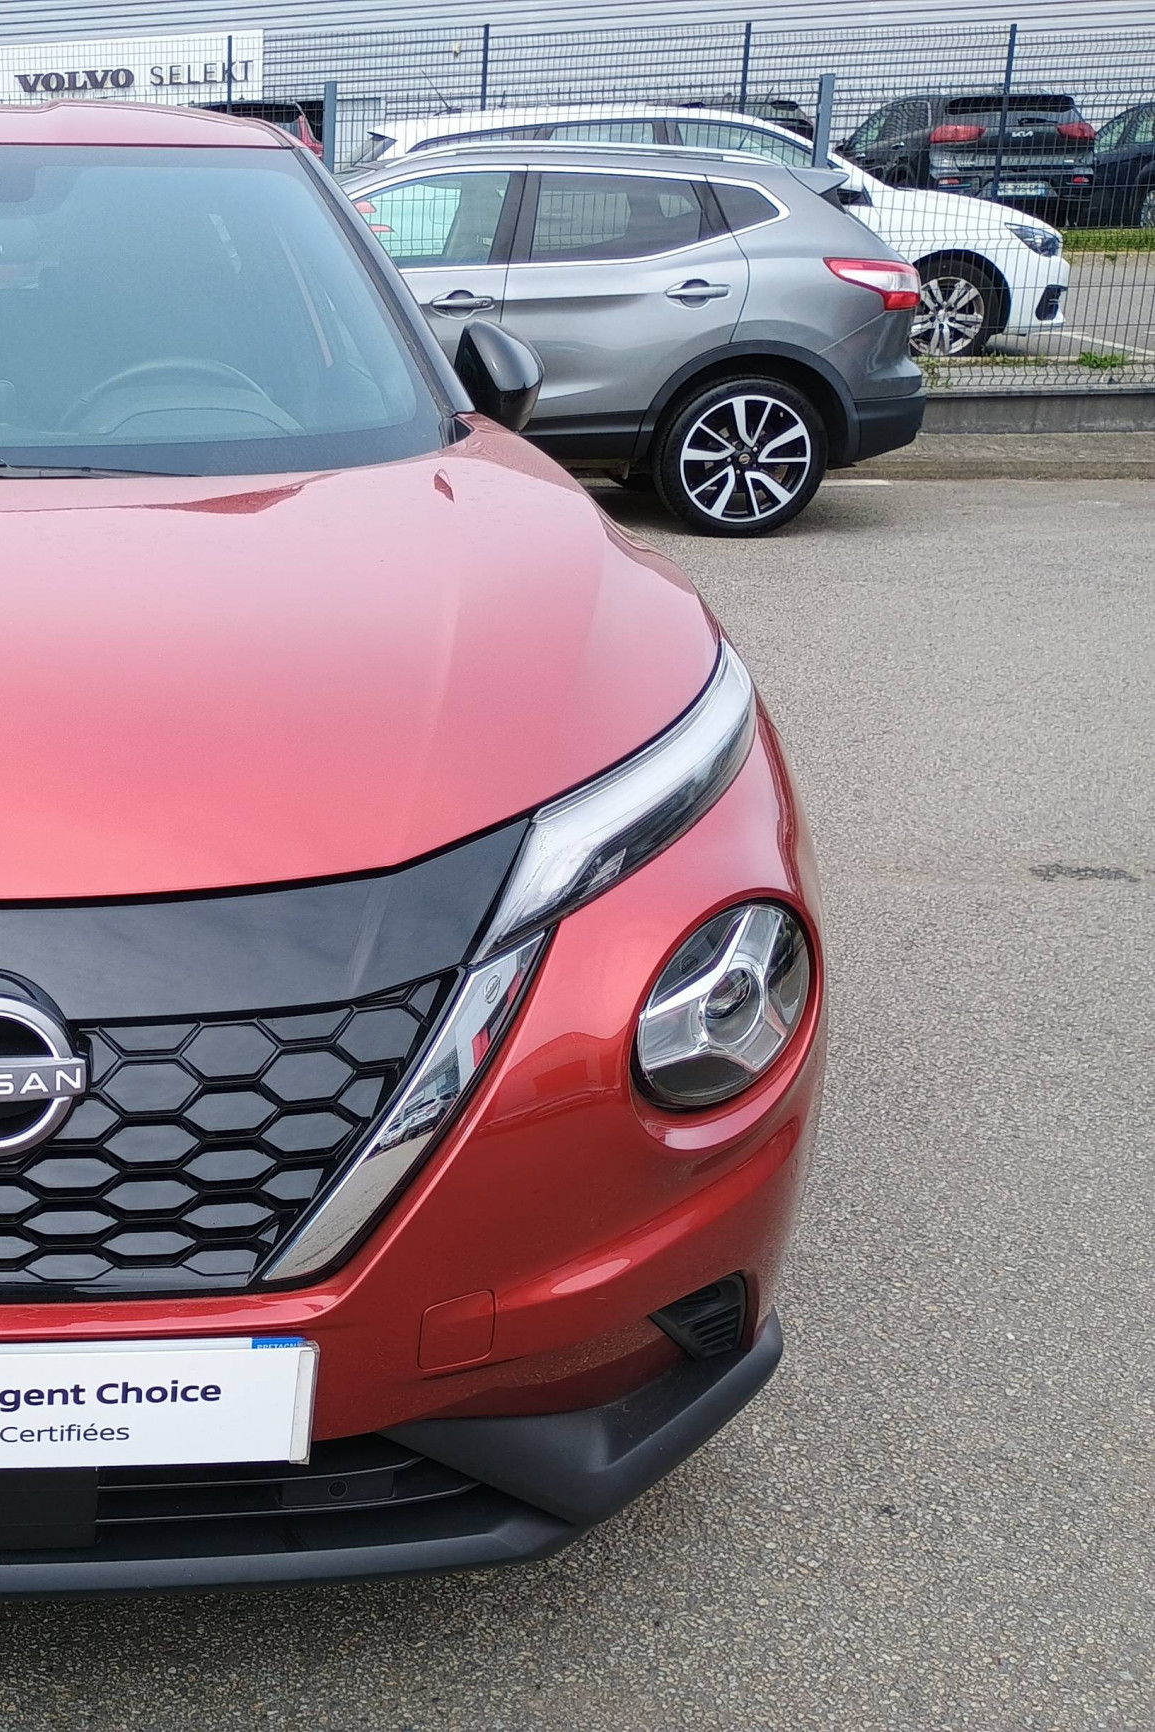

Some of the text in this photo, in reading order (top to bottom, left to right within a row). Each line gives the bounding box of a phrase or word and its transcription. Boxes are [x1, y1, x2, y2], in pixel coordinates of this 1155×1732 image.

[14, 60, 254, 93] VOLVO SELEKT
[96, 1380, 222, 1405] Choice
[0, 1423, 130, 1443] Certifiées
